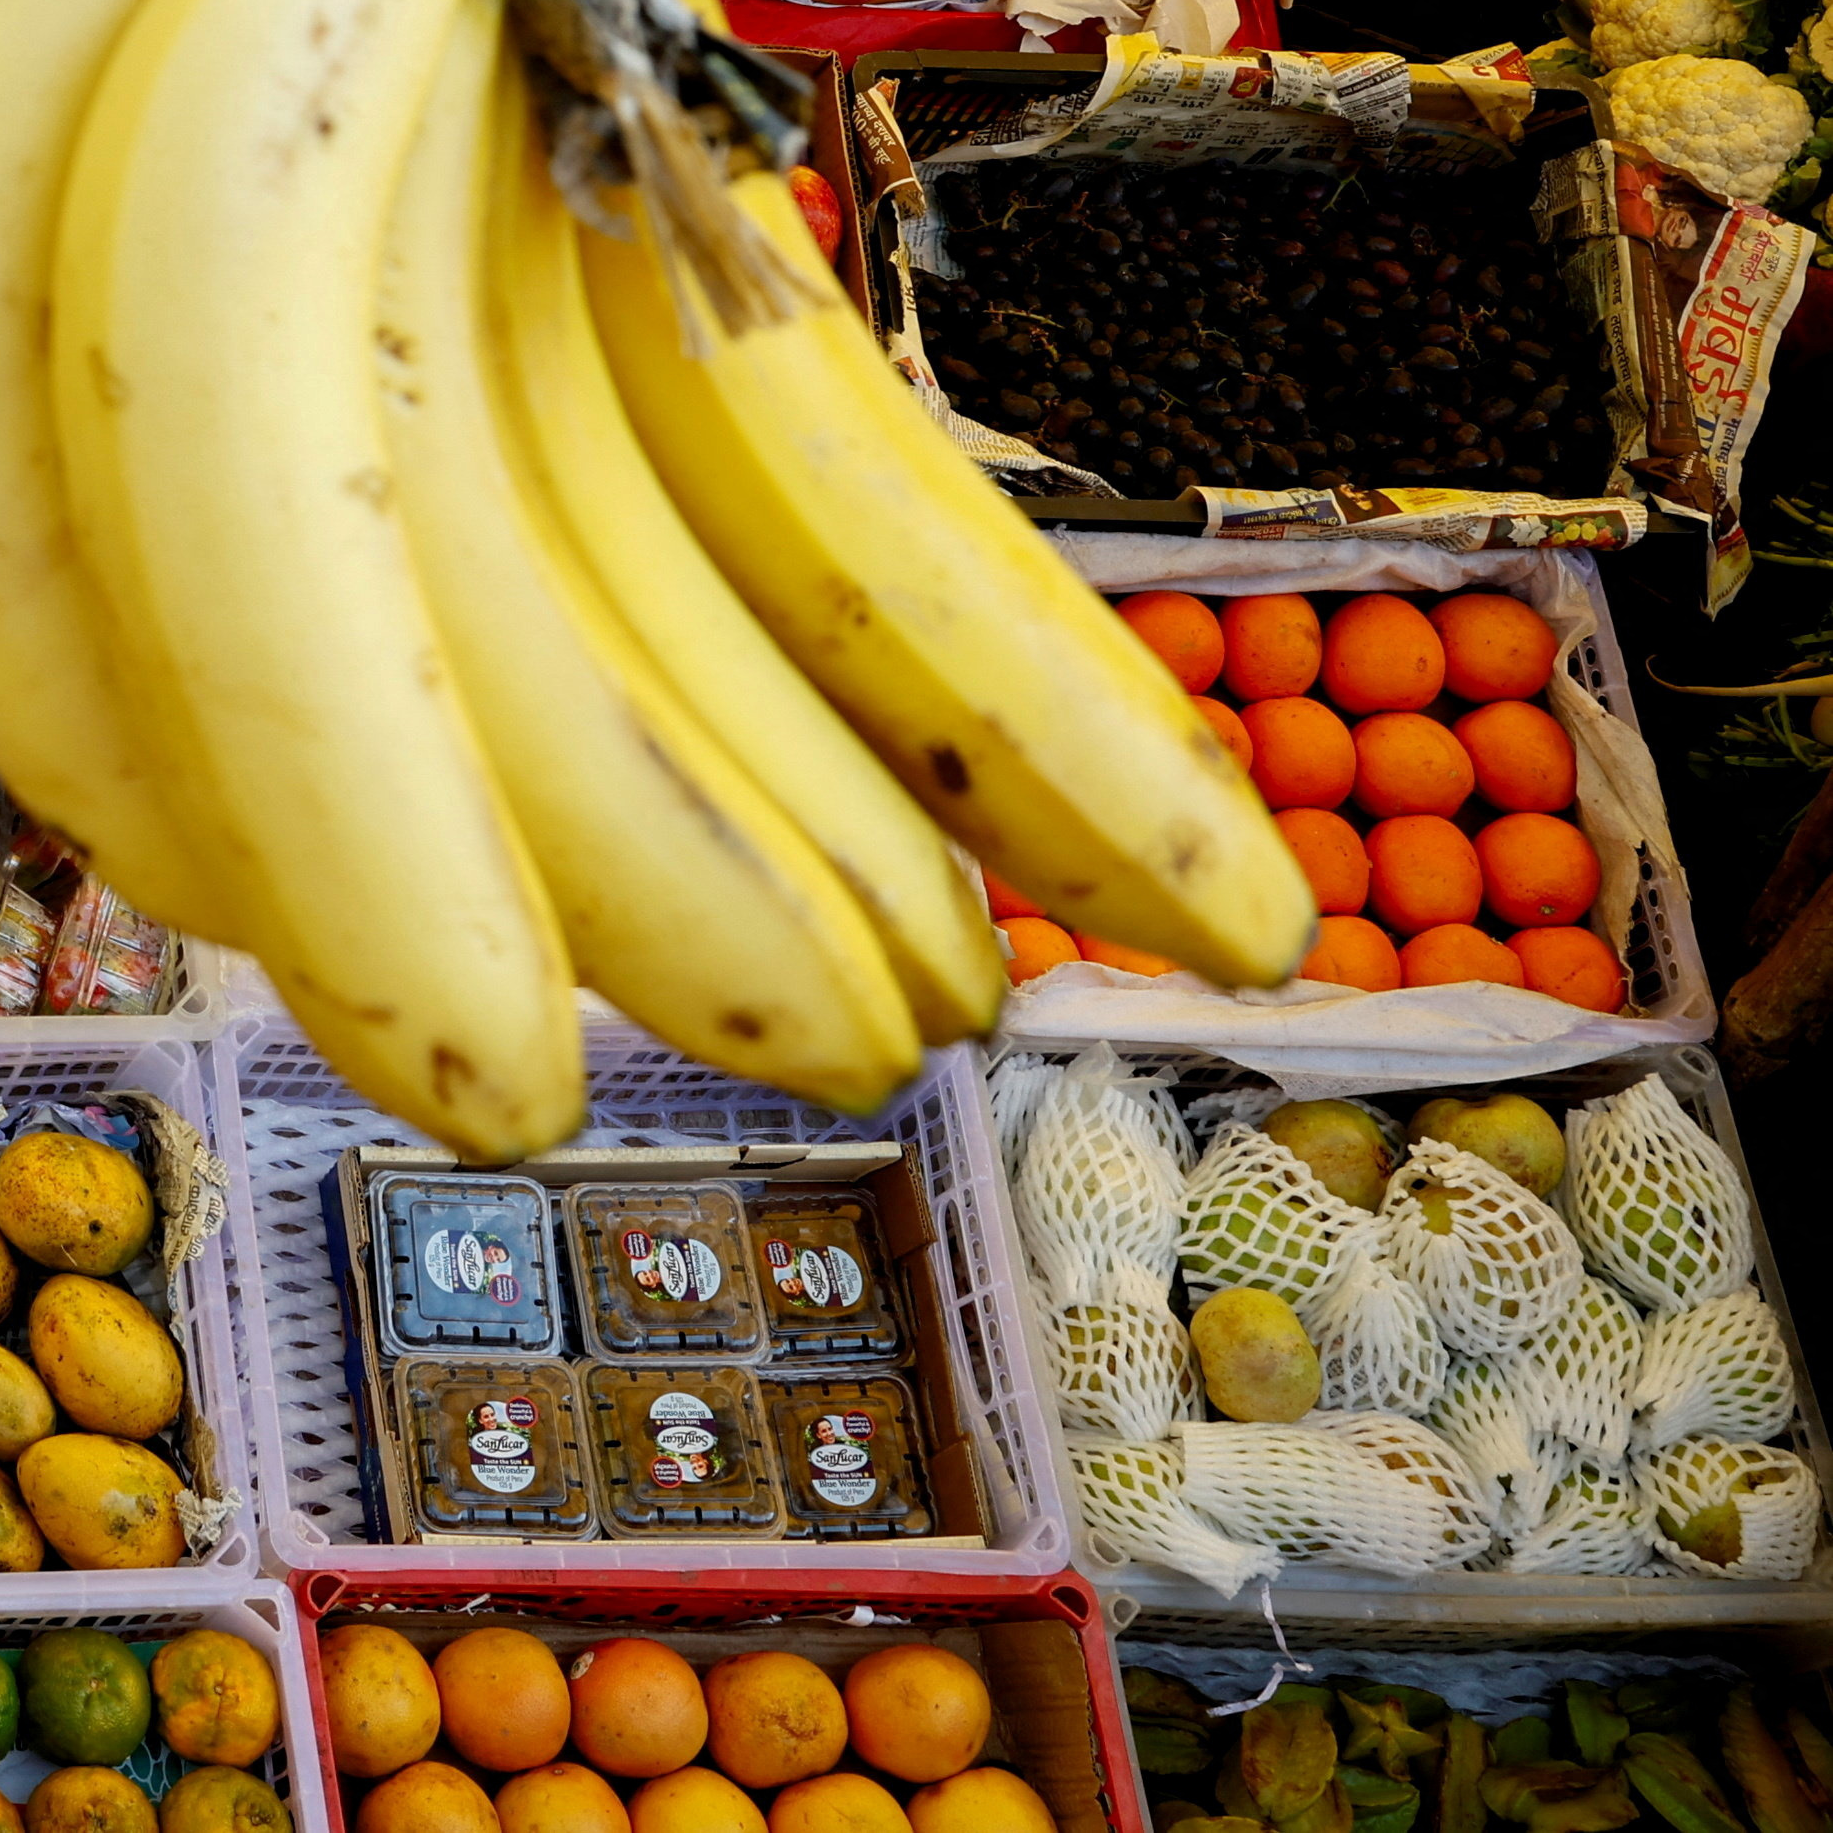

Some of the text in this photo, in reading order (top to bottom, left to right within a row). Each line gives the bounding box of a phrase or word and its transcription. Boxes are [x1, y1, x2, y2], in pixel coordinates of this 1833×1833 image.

[1686, 284, 1765, 408] मुंबई
[461, 1238, 480, 1288] SanLucar
[663, 1245, 684, 1293] SanLucar
[804, 1253, 826, 1300] SanLucar
[655, 1410, 706, 1418] Blue Wonder
[476, 1435, 525, 1453] SanLucar
[661, 1431, 709, 1449] SanLucar
[816, 1449, 864, 1467] SanLucar
[478, 1466, 529, 1474] Blue Wonder
[819, 1479, 871, 1488] Blue Wonder
